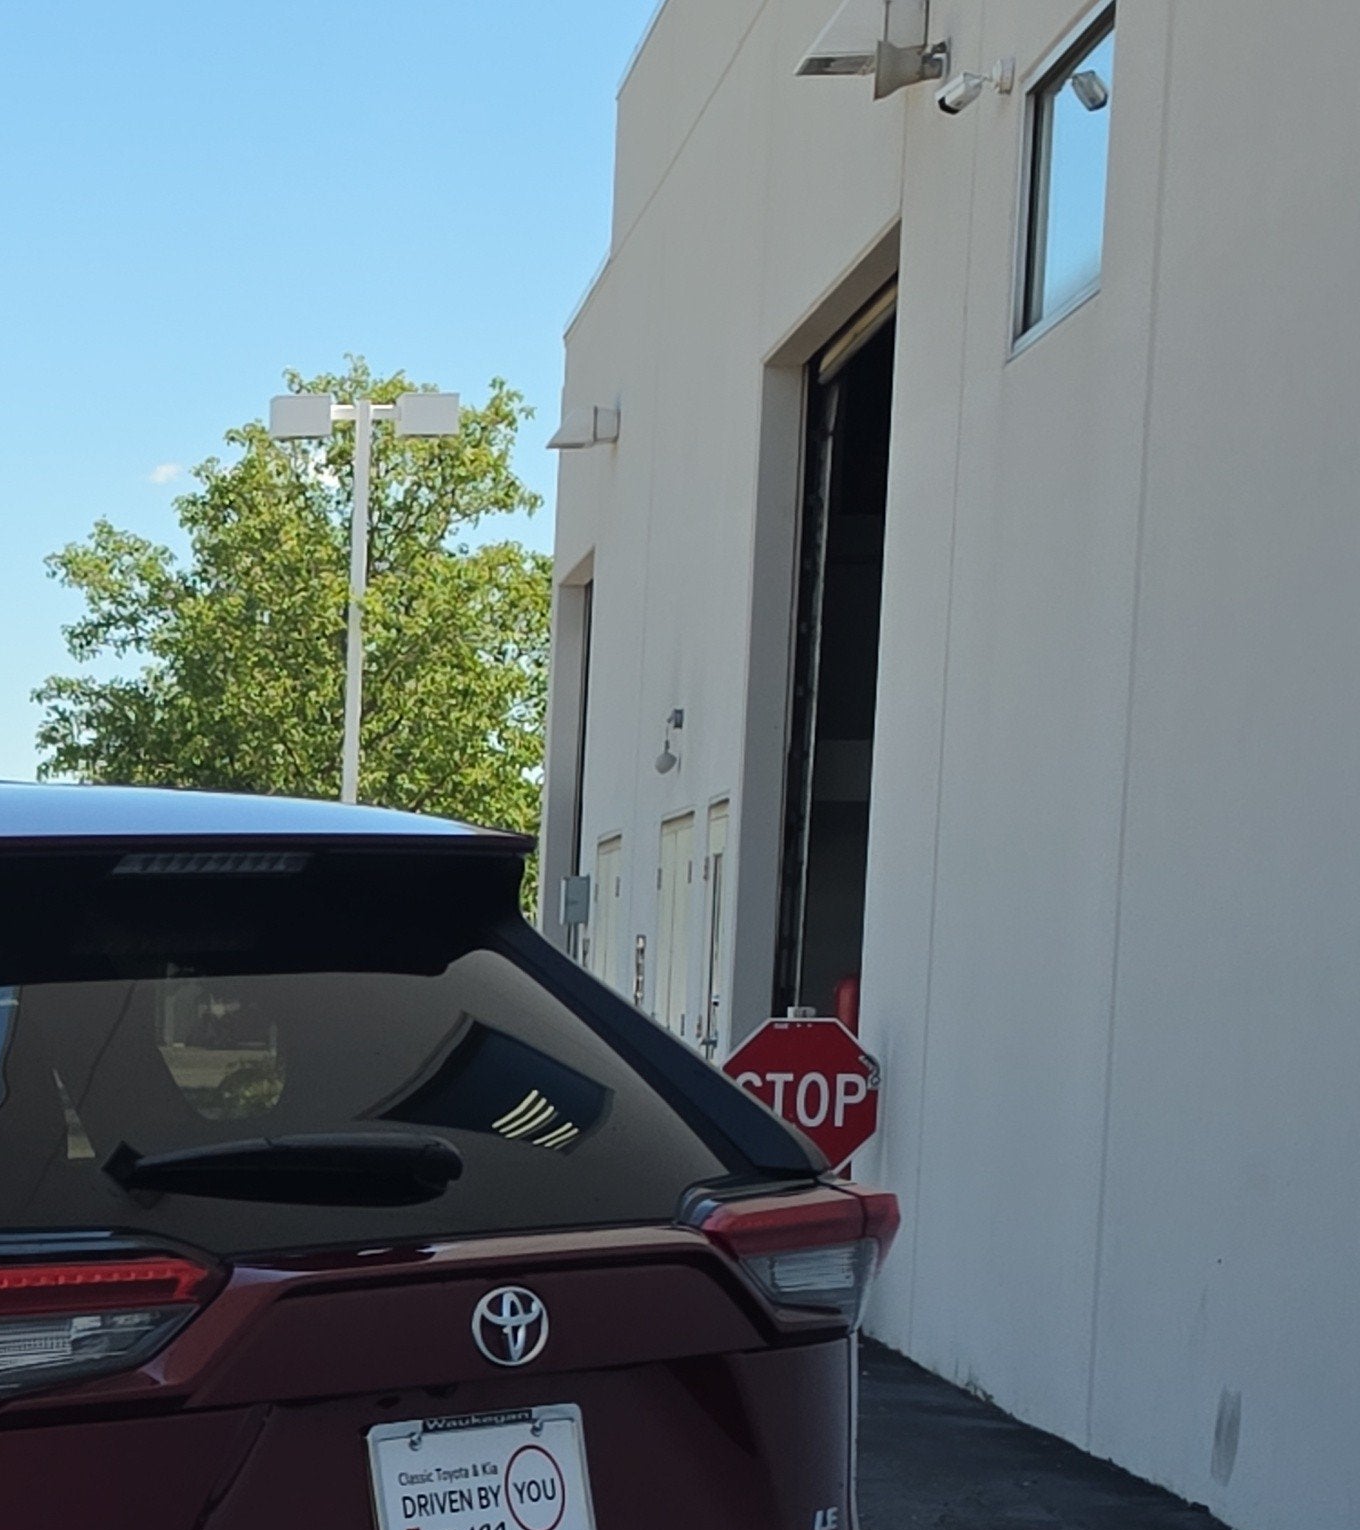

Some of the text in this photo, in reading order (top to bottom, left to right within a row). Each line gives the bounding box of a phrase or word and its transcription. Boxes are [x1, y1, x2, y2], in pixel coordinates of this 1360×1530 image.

[425, 1411, 530, 1430] Waukegan
[398, 1461, 498, 1486] Classic Toyota & Kia
[402, 1477, 556, 1519] DRIVEN BY YOU
